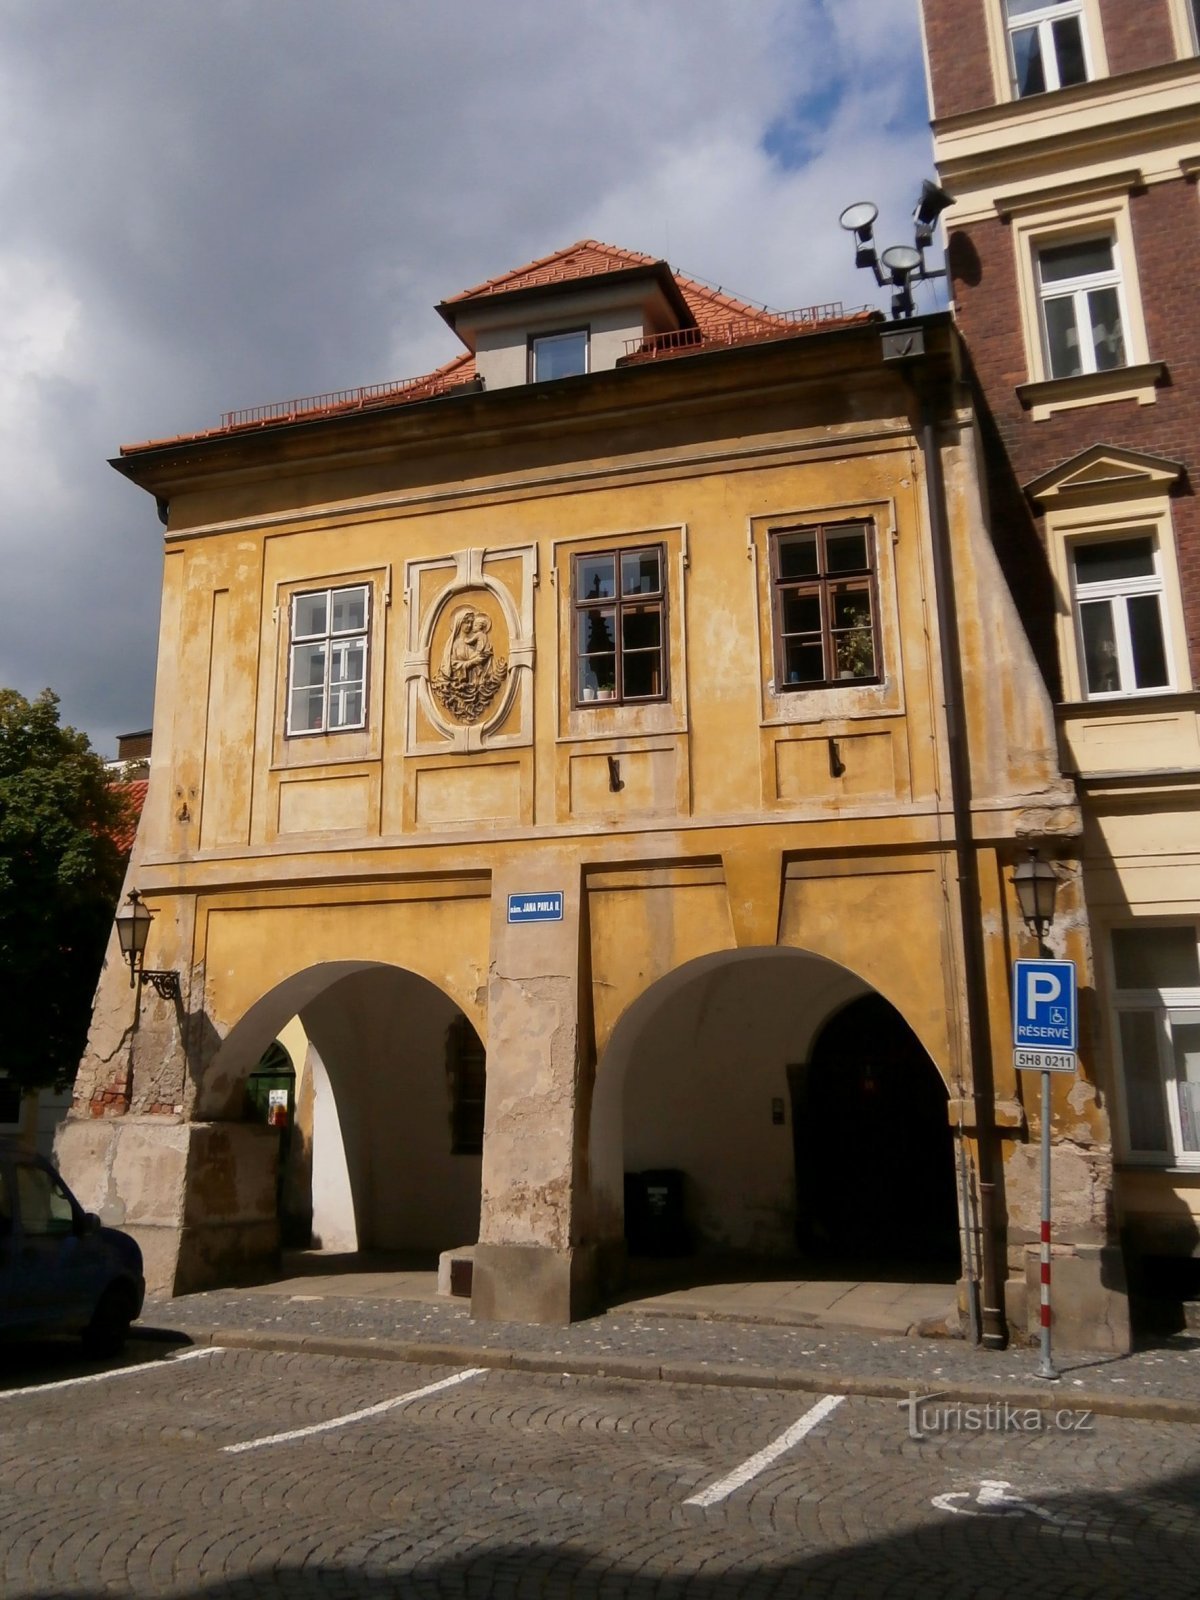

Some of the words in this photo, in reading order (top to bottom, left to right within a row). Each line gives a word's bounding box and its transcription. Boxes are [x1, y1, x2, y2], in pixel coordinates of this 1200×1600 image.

[523, 902, 536, 912] JANA
[537, 901, 553, 911] PAVLA
[1027, 972, 1062, 1020] P
[1019, 1054, 1041, 1065] 5H8
[1045, 1055, 1071, 1067] 0211
